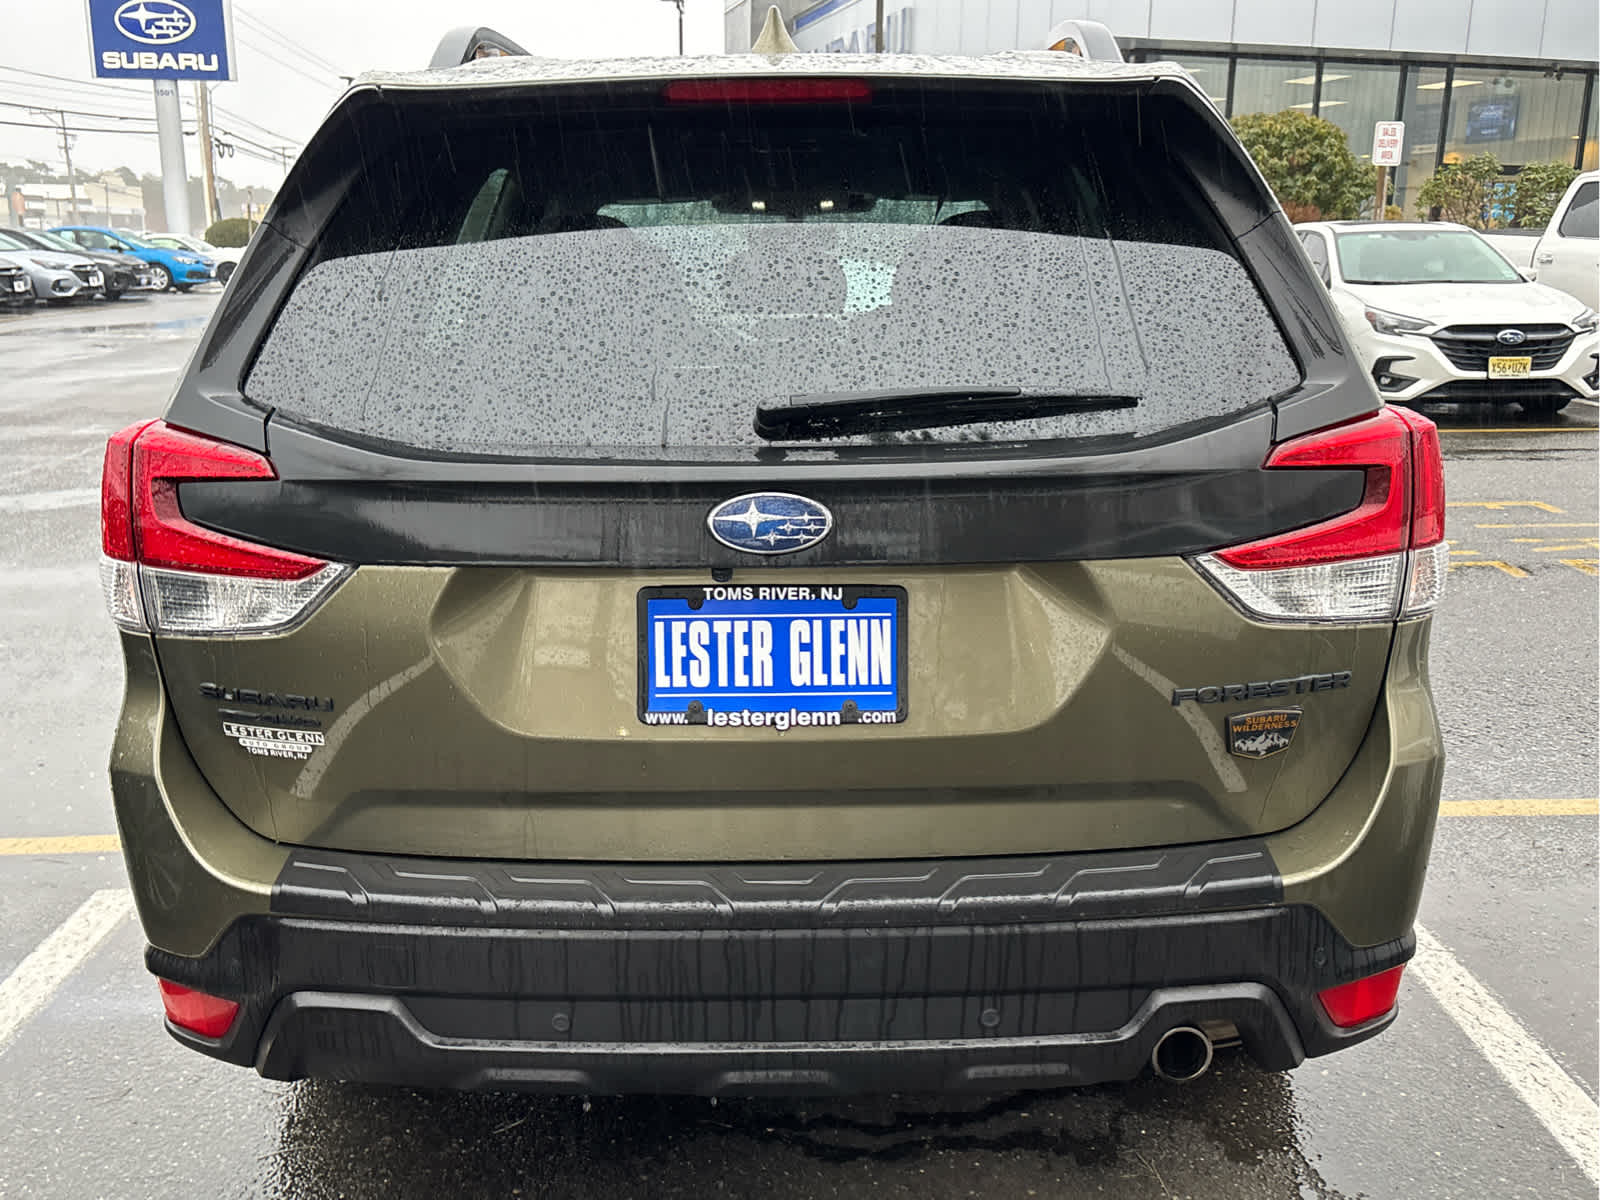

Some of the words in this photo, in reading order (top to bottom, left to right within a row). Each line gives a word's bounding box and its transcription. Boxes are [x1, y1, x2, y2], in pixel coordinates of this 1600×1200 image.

[102, 51, 219, 72] SUBARU
[703, 587, 754, 601] TOMS
[758, 587, 816, 601] RIVER,
[821, 587, 843, 600] NJ
[654, 620, 774, 689] LESTER
[789, 618, 892, 687] GLENN
[199, 681, 335, 713] SUBARU
[1172, 670, 1353, 707] FORESTER
[645, 712, 689, 725] www.
[707, 708, 841, 730] lesterglenn
[857, 710, 897, 724] .com
[1232, 720, 1298, 733] WILDERNESS
[1245, 713, 1288, 725] SUBARU
[223, 723, 273, 740] LESTER
[276, 730, 324, 745] GLENN
[242, 739, 269, 748] AUTO
[273, 743, 309, 752] GROUP
[246, 746, 269, 756] TOMS
[270, 749, 297, 760] RIVER,
[297, 752, 308, 760] NJ
